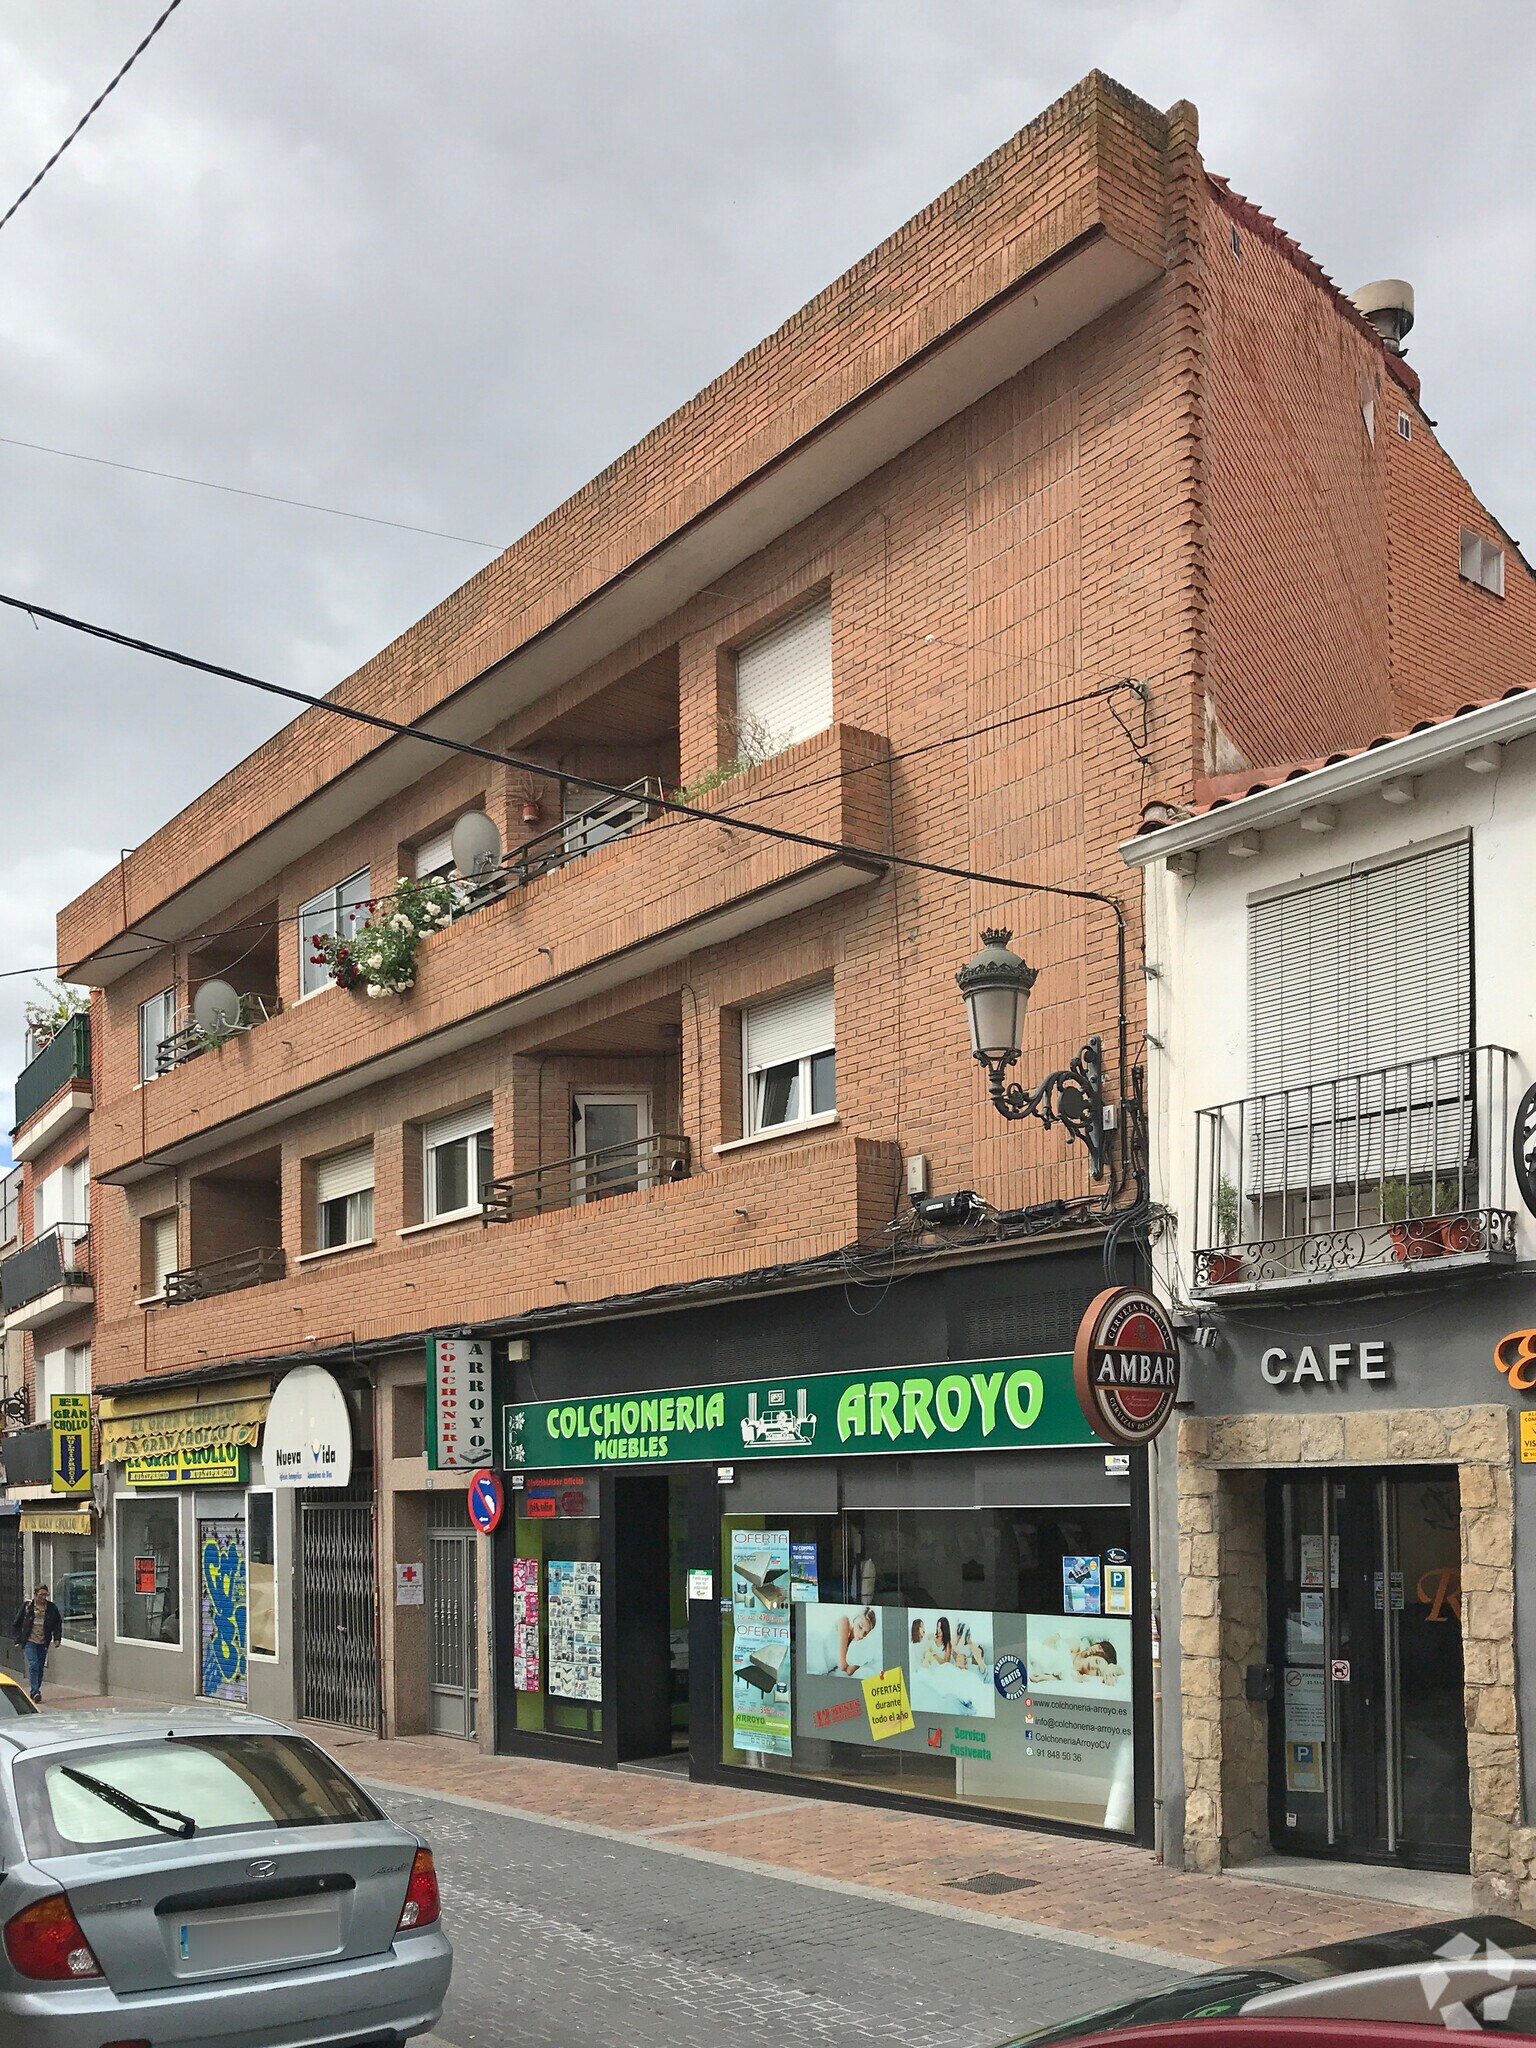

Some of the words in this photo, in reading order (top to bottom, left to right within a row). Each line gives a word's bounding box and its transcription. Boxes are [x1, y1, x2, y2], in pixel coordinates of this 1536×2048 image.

[1108, 1302, 1138, 1339] CERVEZA
[1140, 1302, 1169, 1342] ESPECIAL
[1096, 1353, 1175, 1385] AMBAR
[1260, 1341, 1386, 1385] CAFE
[59, 1398, 83, 1407] EL
[441, 1342, 458, 1465] COLCHONERIA
[468, 1343, 485, 1447] ARROYO
[53, 1409, 87, 1419] GRAN
[837, 1369, 1044, 1443] ARROYO
[1109, 1397, 1135, 1429] CERVEZAS
[546, 1392, 725, 1440] COLCHONERIA
[53, 1420, 88, 1432] CHOLLO
[594, 1436, 668, 1460] MUEBLES
[276, 1449, 302, 1466] Nueva
[130, 1471, 170, 1480] MULTIPRECIO
[190, 1468, 234, 1479] MULTIPRECIO
[734, 1533, 788, 1544] OFERTA
[736, 1624, 789, 1639] OFERTA
[1000, 1668, 1022, 1688] GRATIS
[871, 1683, 902, 1697] OFERTAS
[875, 1699, 902, 1710] durante
[1033, 1700, 1128, 1716] www.colchoneria-arroyo.es
[736, 1714, 766, 1725] ARROYO
[816, 1708, 831, 1727] 12
[872, 1713, 888, 1725] todo
[888, 1712, 896, 1722] el
[895, 1711, 909, 1722] año
[1035, 1717, 1132, 1736] info@colchoneria-arroyo.es
[1035, 1732, 1111, 1749] ColchoneriaArroyoCV
[950, 1743, 992, 1760] Postventa
[1036, 1748, 1046, 1757] 91
[1047, 1749, 1060, 1760] 848
[1061, 1751, 1071, 1761] 50
[1072, 1752, 1082, 1762] 36
